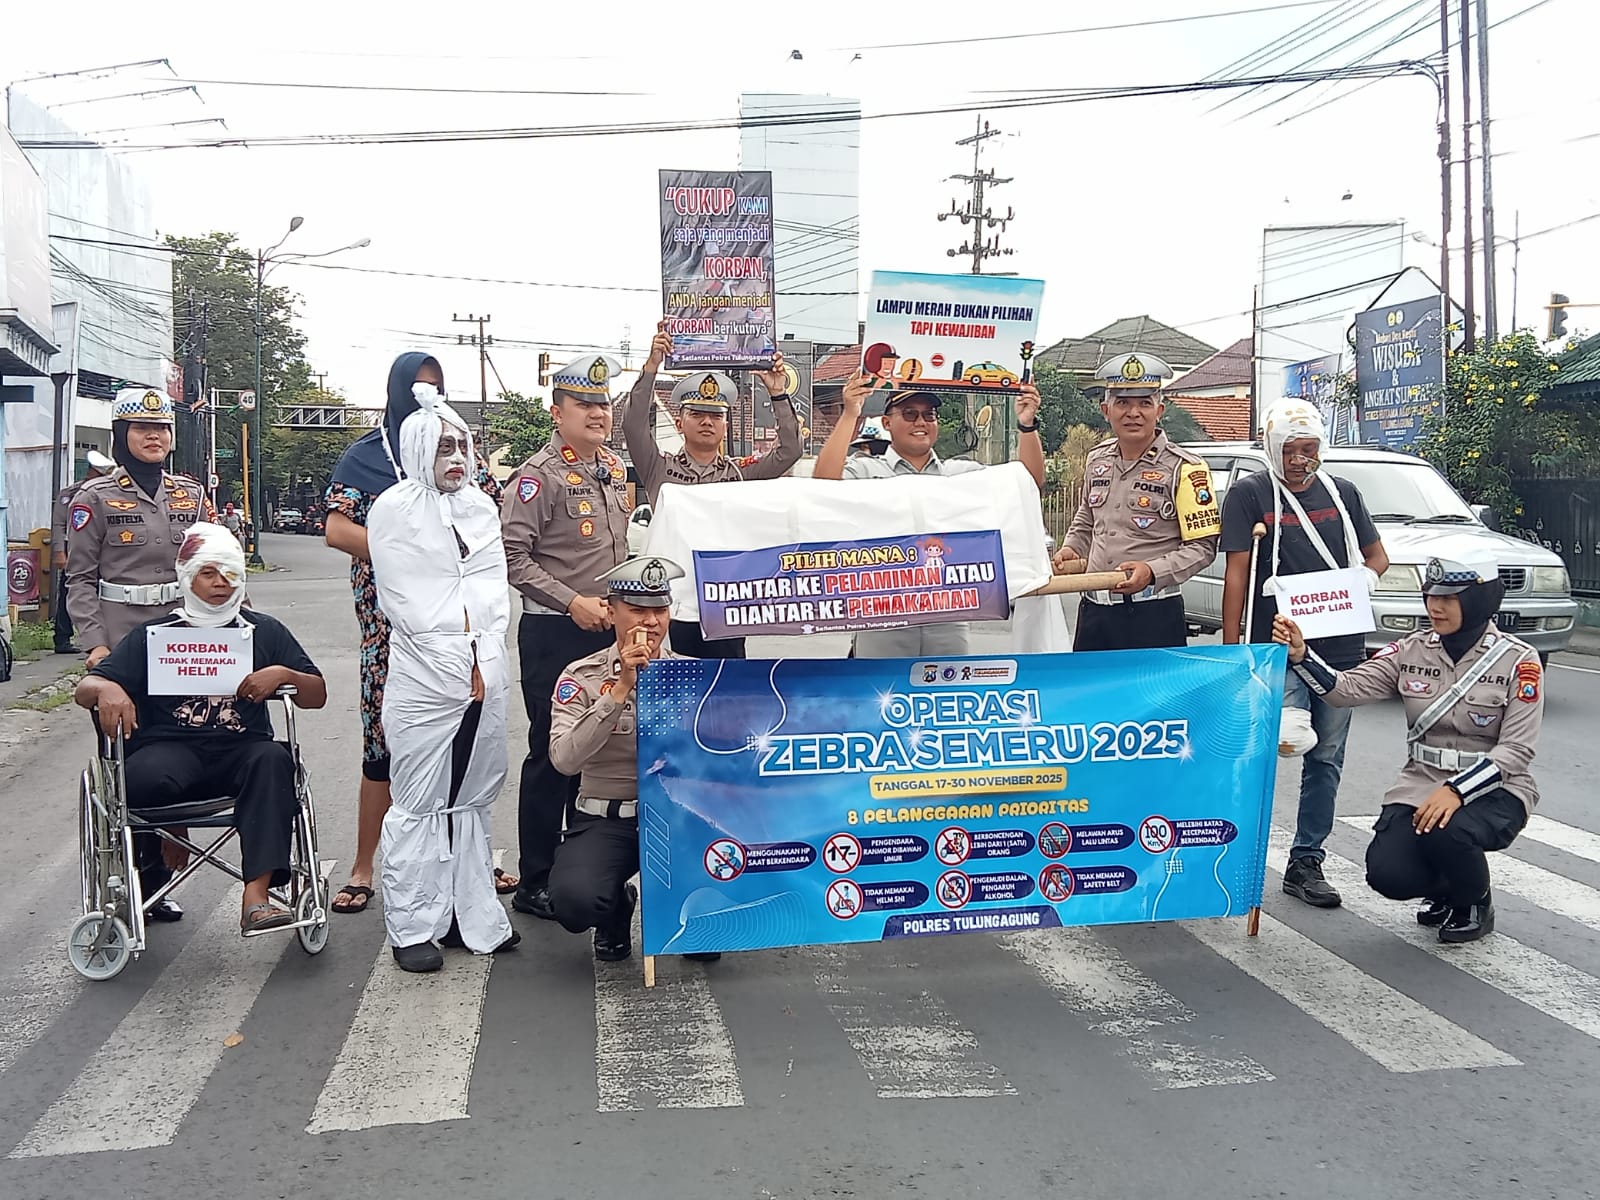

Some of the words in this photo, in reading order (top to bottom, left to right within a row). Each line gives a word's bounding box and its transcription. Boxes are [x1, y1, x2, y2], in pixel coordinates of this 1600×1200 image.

[736, 196, 769, 216] KAMI
[674, 224, 697, 246] saja
[697, 227, 725, 246] yang
[725, 224, 769, 246] menjadi
[704, 257, 768, 283] KORBAN,
[669, 293, 698, 307] ANDA
[698, 294, 731, 311] jangan
[732, 292, 771, 309] menjadi
[876, 299, 913, 315] LAMPU
[914, 303, 951, 317] MERAH
[953, 305, 989, 319] BUKAN
[991, 307, 1034, 322] PILIHAN
[669, 319, 713, 335] KORBAN
[911, 321, 933, 335] TAPI
[935, 324, 995, 339] KEWAJIBAN
[711, 353, 731, 361] Polres
[732, 354, 772, 362] Tulungagung
[1372, 340, 1422, 372] WISUDA
[1392, 369, 1399, 386] &
[243, 396, 253, 404] 40
[1363, 388, 1395, 408] ANGKAT
[1133, 482, 1165, 495] POLRI
[780, 550, 839, 571] PILIH
[841, 546, 906, 568] MANA
[703, 577, 792, 602] DIANTAR
[796, 575, 822, 596] KE
[824, 567, 941, 595] PELAMINAN
[945, 563, 996, 585] ATAU
[1290, 589, 1350, 606] KORBAN
[725, 602, 815, 626] DIANTAR
[816, 599, 844, 619] KE
[848, 589, 980, 618] PEMAKAMAN
[1291, 605, 1326, 617] BALAP
[1328, 602, 1353, 612] LIAR
[1504, 613, 1516, 626] TY
[166, 643, 229, 653] KORBAN
[177, 666, 218, 676] HELM
[1400, 663, 1441, 678] RETNO
[1478, 674, 1511, 687] OLRI
[882, 690, 1040, 727] OPERASI
[759, 731, 913, 776] ZEBRA
[911, 724, 1089, 770] SEMERU
[1091, 720, 1190, 761] 2025
[874, 780, 933, 792] TANGGAL
[935, 778, 966, 789] 17-30
[968, 775, 1034, 788] NOVEMBER
[1036, 774, 1063, 784] 2025
[847, 810, 859, 824] 8
[863, 804, 994, 824] PELANGGARAN
[998, 799, 1089, 817] PRIORITAS
[974, 832, 1024, 841] BERBONCENGAN
[1076, 830, 1106, 838] MELAWAN
[1107, 829, 1124, 837] ARUS
[1145, 825, 1167, 838] 100
[871, 838, 914, 847] PENGENDARA
[970, 840, 984, 849] LEBIH
[984, 840, 1003, 848] DARI
[1007, 839, 1028, 847] (SATU)
[1081, 838, 1096, 846] LALU
[1097, 837, 1119, 845] LINTAS
[1180, 837, 1221, 845] BERKENDARA
[746, 848, 800, 857] MENGGUNAKAN
[800, 847, 811, 855] HP
[863, 846, 892, 856] RANMOR
[892, 845, 922, 854] DIBAWAH
[987, 848, 1010, 856] ORANG
[748, 858, 765, 867] SAAT
[766, 856, 810, 865] BERKENDARA
[883, 855, 903, 863] UMUR
[970, 876, 1005, 884] PENGEMUDI
[1005, 874, 1028, 882] DALAM
[1076, 873, 1095, 881] TIDAK
[1095, 871, 1125, 880] MEMAKAI
[981, 884, 1015, 892] PENGARUH
[1083, 880, 1106, 889] SAFETY
[1106, 879, 1121, 888] BELT
[864, 888, 883, 896] TIDAK
[884, 886, 915, 895] MEMAKAI
[984, 891, 1014, 900] ALKOHOL
[876, 896, 893, 904] HELM
[894, 895, 906, 903] SNI
[903, 920, 950, 934] POLRES
[953, 912, 1040, 931] TULUNGAGUNG
